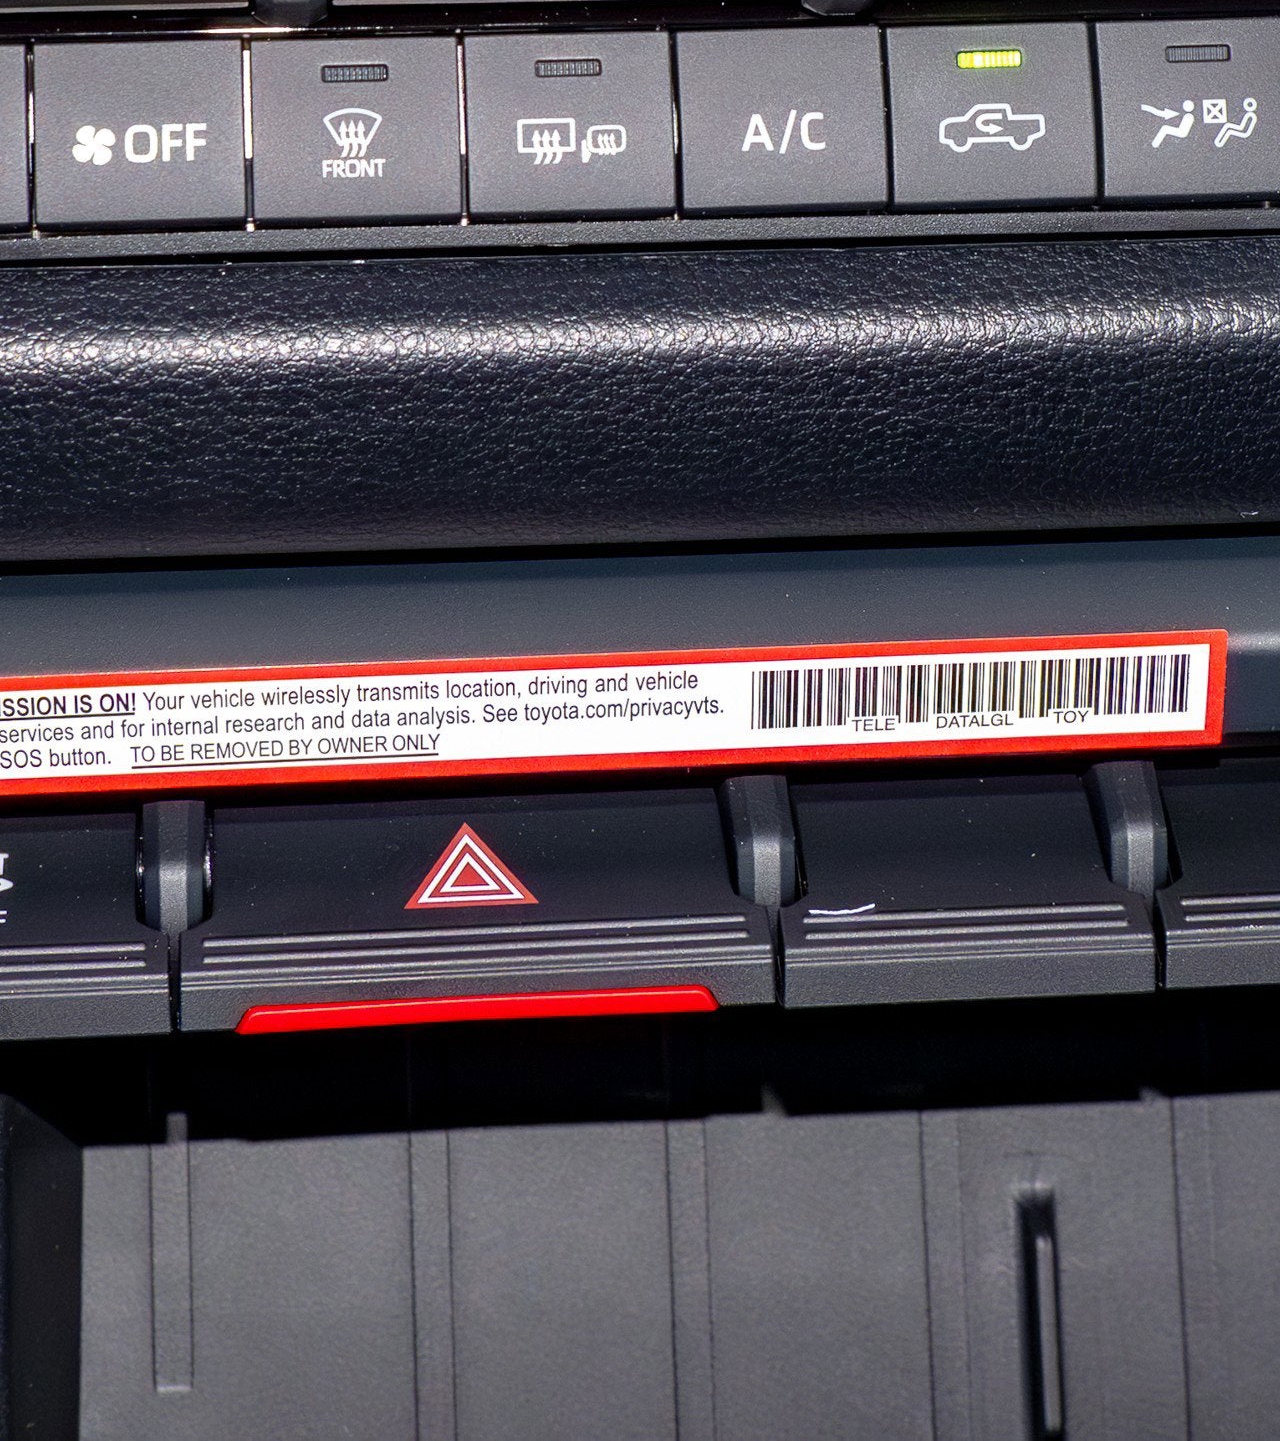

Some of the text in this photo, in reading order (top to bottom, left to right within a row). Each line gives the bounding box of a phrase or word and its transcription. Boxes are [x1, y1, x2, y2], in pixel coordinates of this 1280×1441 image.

[123, 122, 207, 164] OFF
[741, 108, 826, 155] A/C
[321, 158, 387, 179] FRONT
[74, 695, 92, 712] IS
[99, 692, 136, 712] ON!
[143, 691, 185, 712] Your
[191, 688, 255, 708] vehicle
[261, 684, 351, 707] wirelessly
[357, 681, 440, 702] transmits
[446, 680, 521, 698] location,
[528, 676, 587, 698] driving
[595, 673, 628, 692] and
[635, 671, 698, 690] vehicle
[81, 720, 114, 739] and
[121, 720, 144, 738] for
[152, 716, 218, 737] internal
[225, 713, 304, 733] research
[312, 711, 344, 729] and
[351, 709, 390, 728] data
[397, 706, 476, 730] analysis.
[482, 704, 518, 723] See
[524, 696, 724, 724] toyota.com/privacyvts.
[852, 718, 895, 732] TELE
[936, 713, 1014, 729] DATALGL
[1053, 710, 1089, 724] TOY
[0, 750, 42, 769] SOS
[49, 749, 112, 766] button.
[130, 733, 440, 762] TO BE REMOVED BY OWNER ONLY
